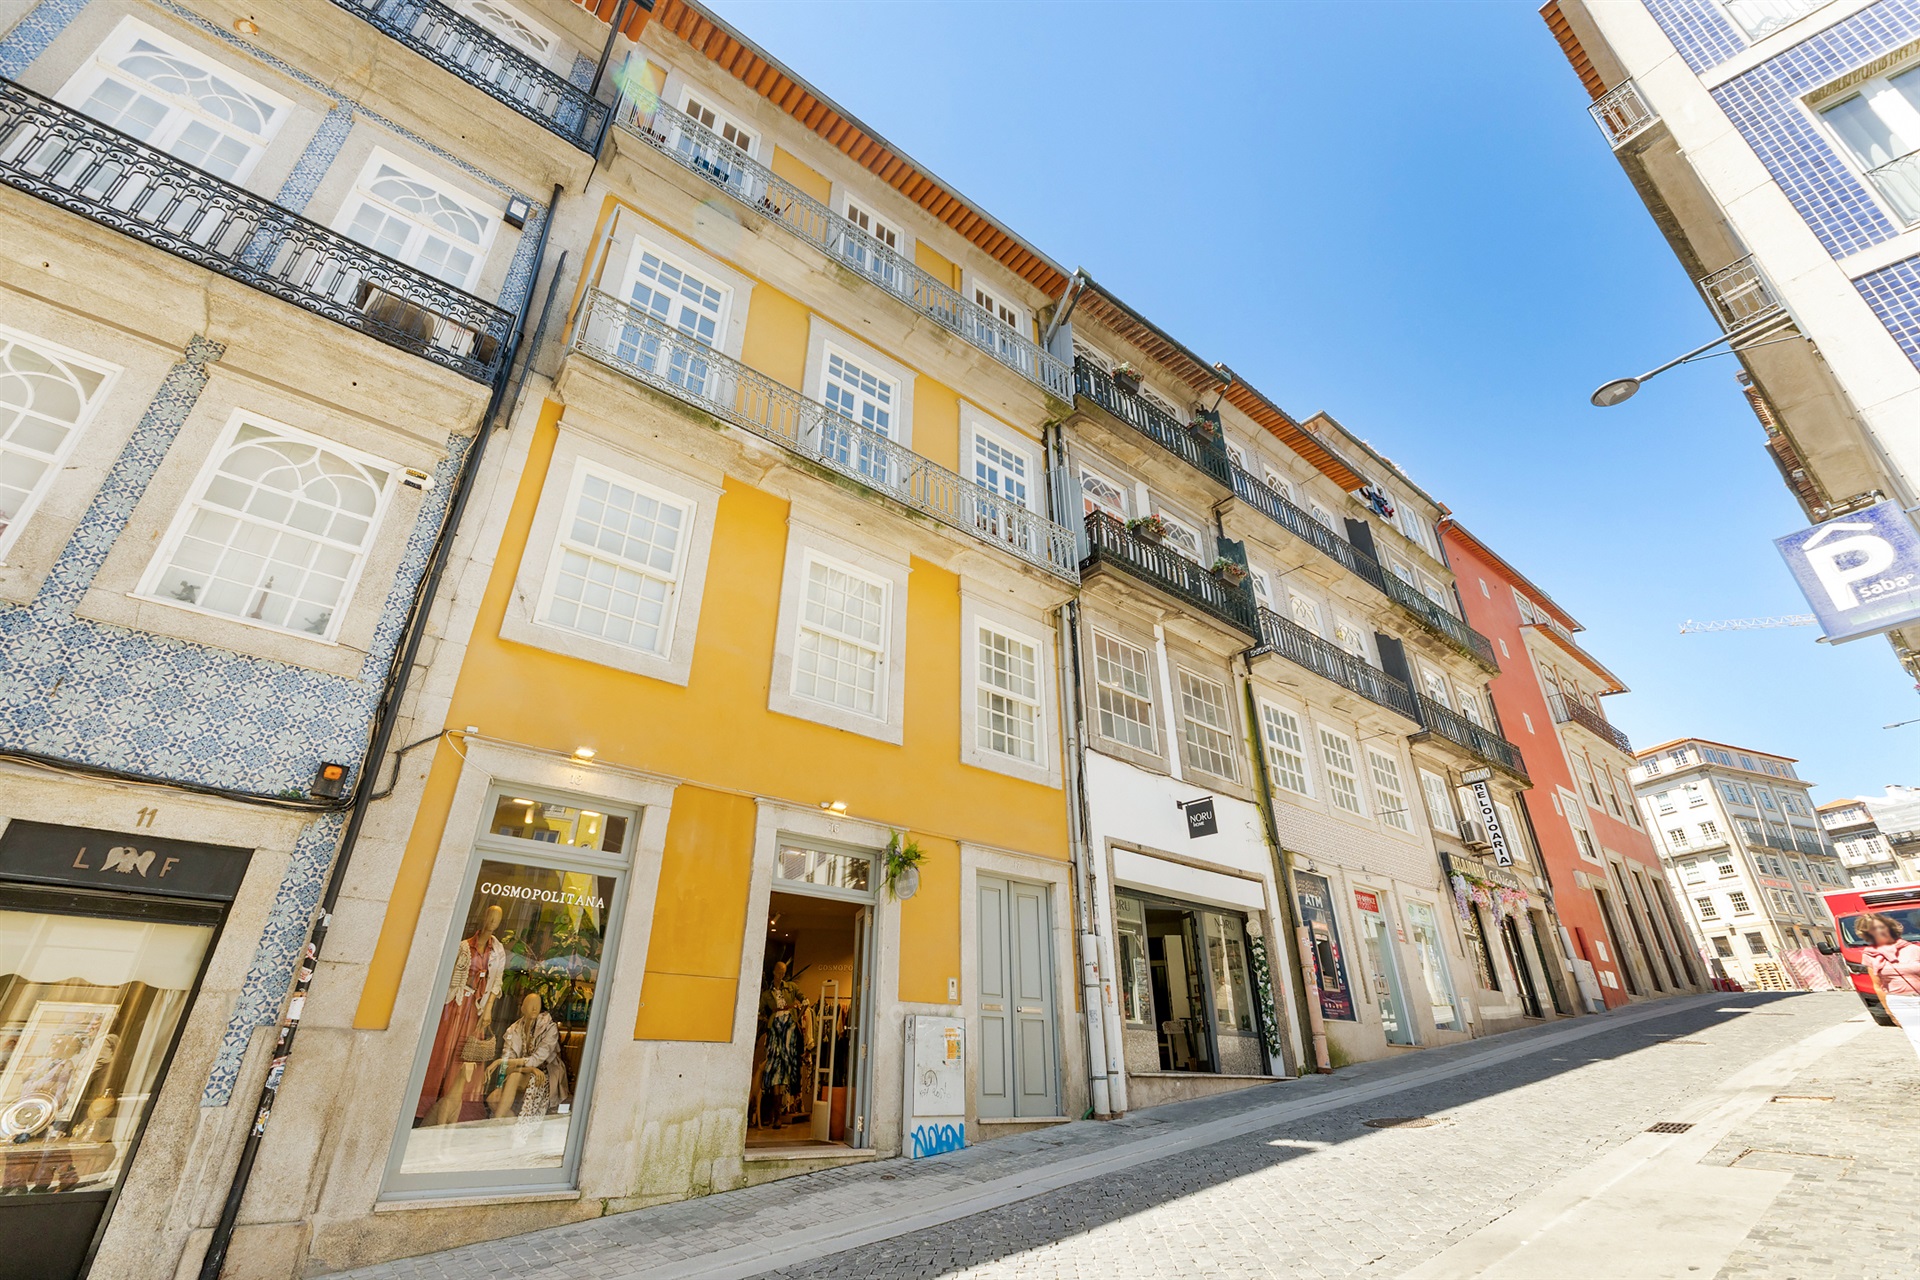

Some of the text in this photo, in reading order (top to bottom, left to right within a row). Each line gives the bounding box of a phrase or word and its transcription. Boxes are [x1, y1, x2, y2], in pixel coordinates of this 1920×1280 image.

[1805, 534, 1895, 613] P
[136, 807, 158, 828] 11
[1190, 811, 1212, 824] NORU
[1474, 783, 1510, 865] RELOJOARIA
[72, 847, 180, 877] L F
[480, 882, 605, 909] COSMOPOLITANA
[1305, 894, 1324, 909] ATM
